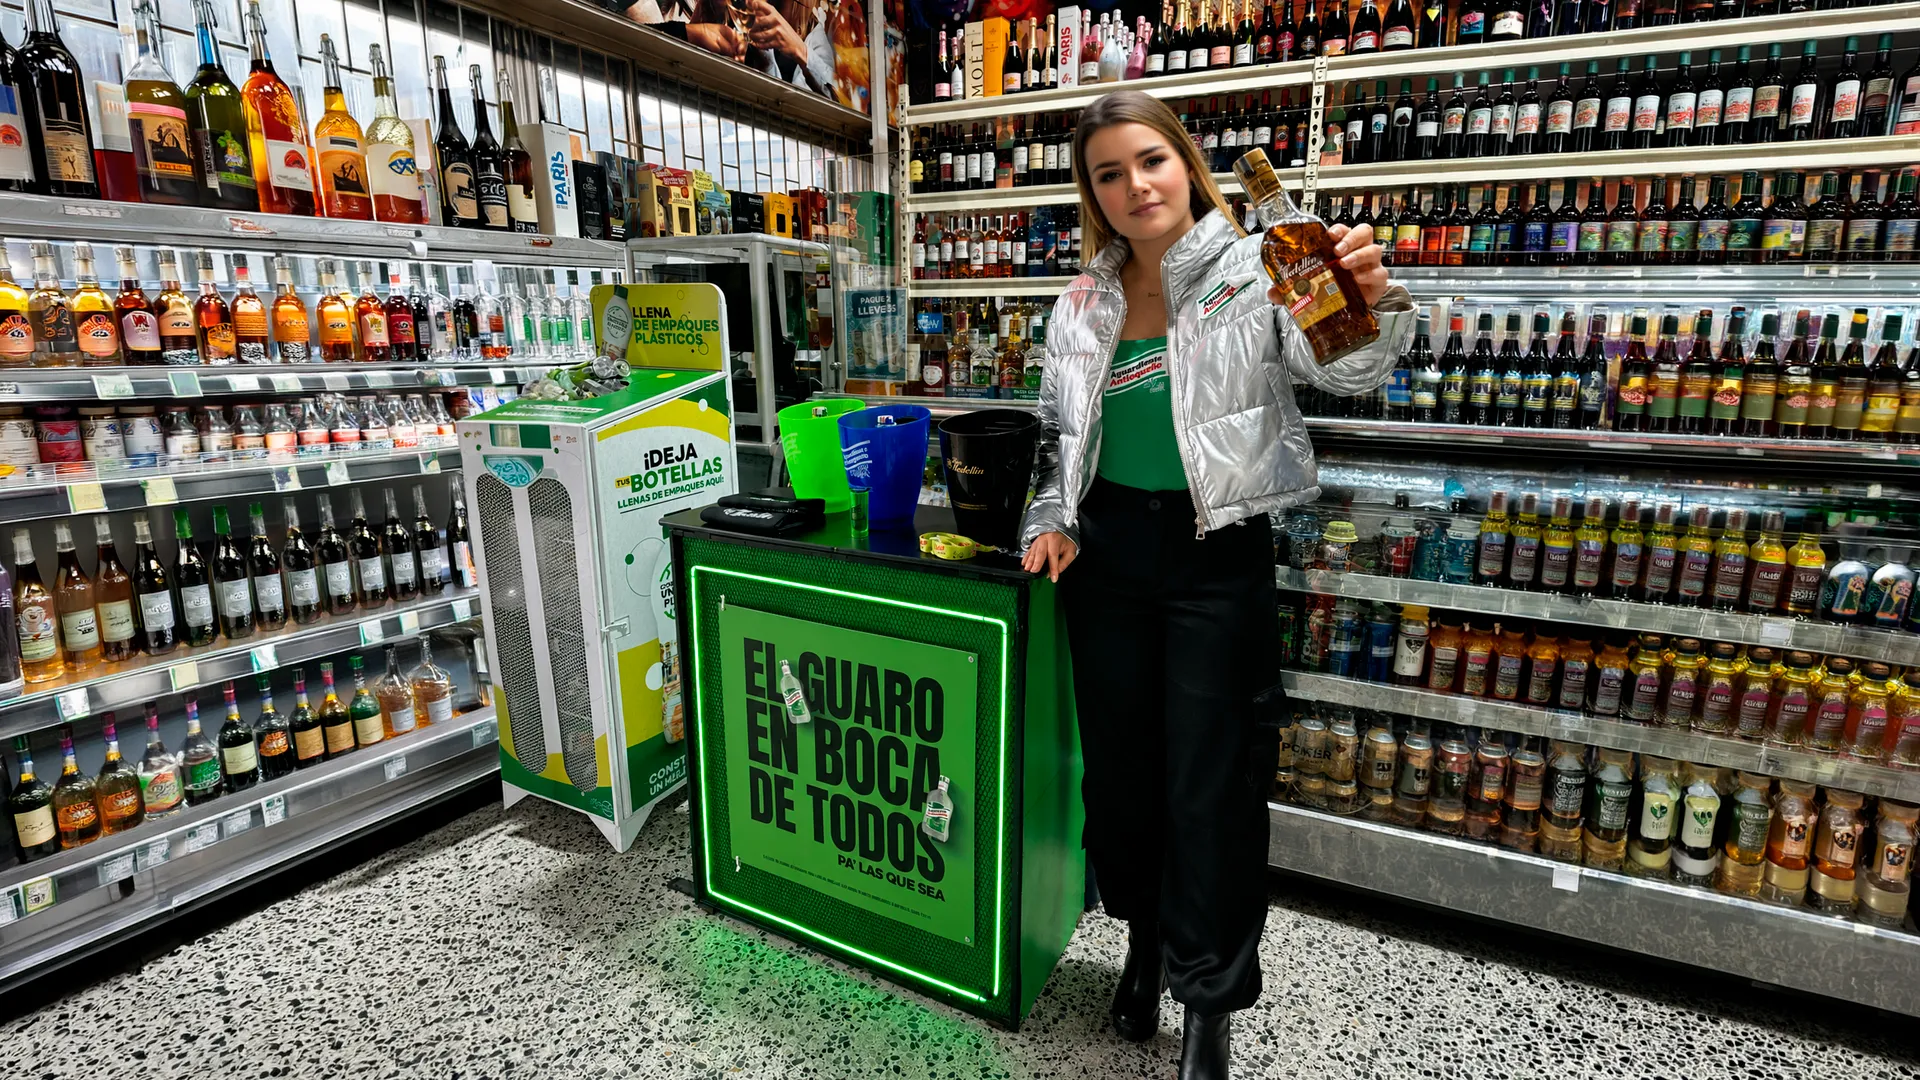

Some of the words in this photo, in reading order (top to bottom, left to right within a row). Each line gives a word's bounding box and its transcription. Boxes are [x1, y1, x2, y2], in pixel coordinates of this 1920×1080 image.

[551, 151, 568, 205] PARIS
[632, 307, 672, 318] LLENA
[633, 320, 649, 330] DE
[652, 320, 719, 333] EMPAQUES
[635, 330, 703, 345] PLÁSTICOS
[616, 477, 630, 487] TUS
[630, 456, 723, 493] BOTELLAS
[617, 493, 650, 509] LLENAS
[652, 490, 663, 501] DE
[664, 480, 704, 498] EMPAQUES
[744, 637, 786, 704] EL
[798, 651, 944, 744] GUARO
[745, 697, 799, 775] EN
[649, 754, 686, 784] CONST
[814, 717, 941, 813] BOCA
[650, 781, 663, 796] UN
[749, 765, 797, 834] DE
[806, 784, 946, 883] TODOS
[859, 861, 884, 880] LAS
[886, 872, 915, 891] QUE
[917, 882, 946, 902] SEA
